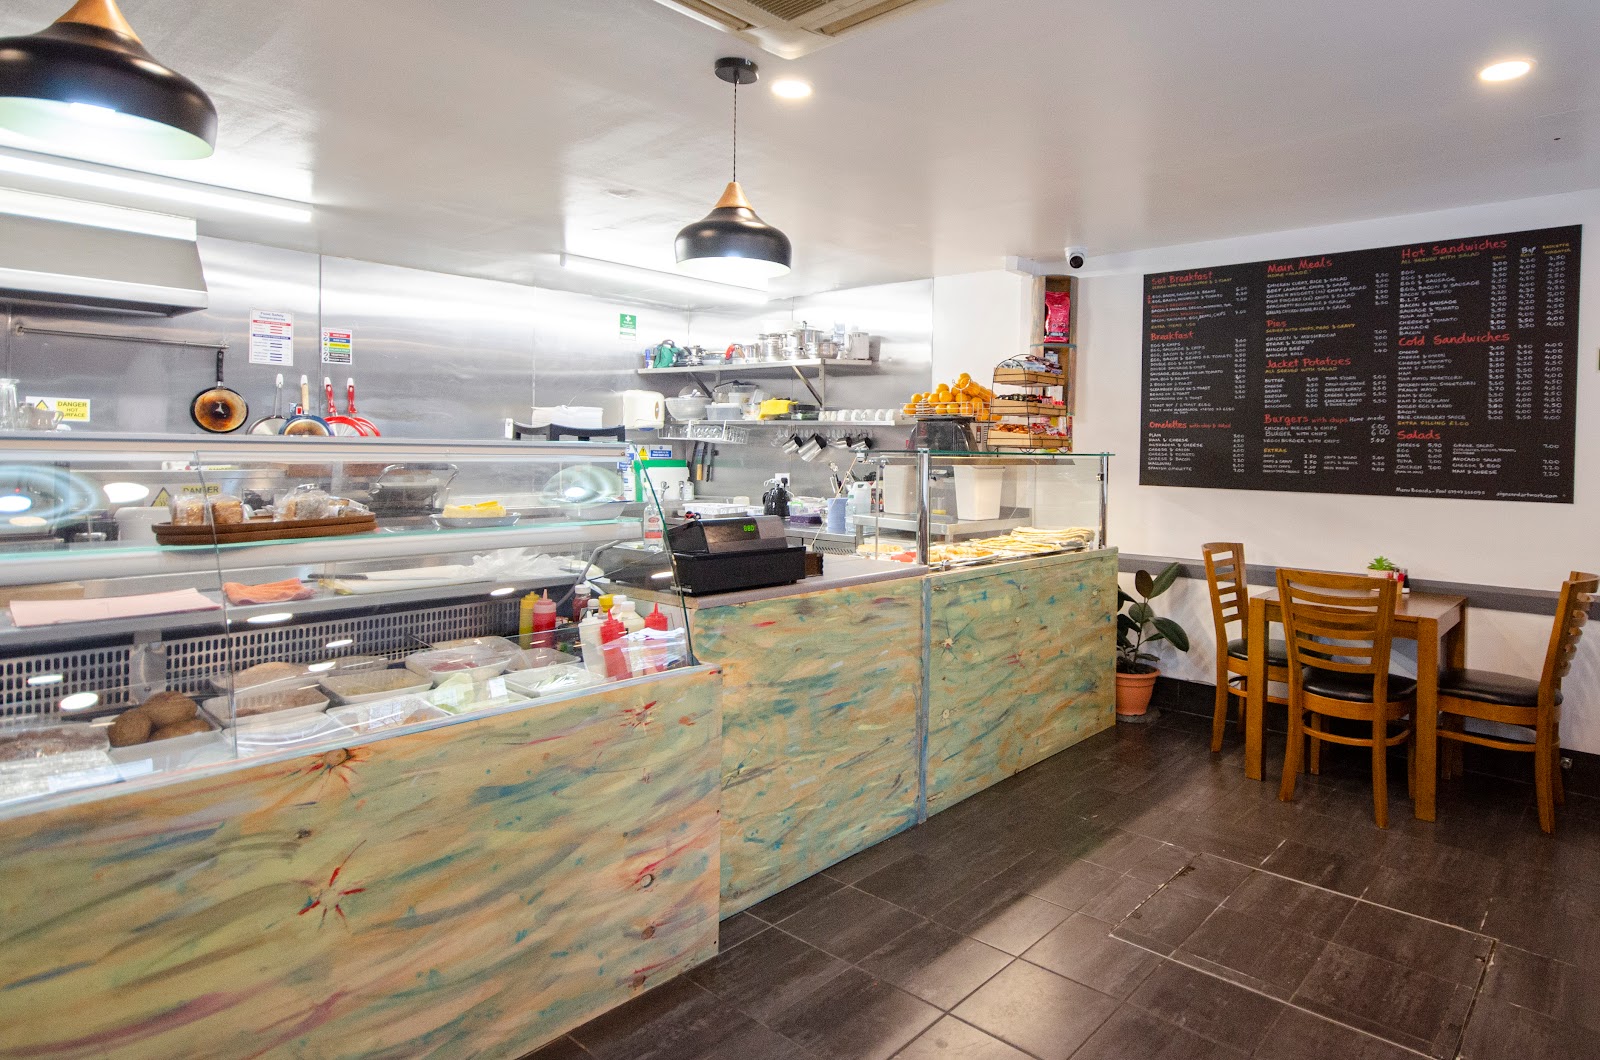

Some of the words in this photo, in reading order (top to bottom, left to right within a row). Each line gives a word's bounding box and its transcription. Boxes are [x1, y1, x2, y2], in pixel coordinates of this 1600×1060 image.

[1402, 249, 1425, 259] Hot
[1433, 239, 1507, 255] Sandwiches
[1268, 264, 1294, 273] Main
[1299, 258, 1332, 269] Meals
[1152, 277, 1166, 285] Set
[1169, 270, 1212, 283] Breakfast
[1151, 331, 1193, 340] Breakfast
[1399, 336, 1425, 346] Cold
[1434, 333, 1509, 345] Sandwiches
[1266, 359, 1299, 368] Jacket
[1303, 357, 1351, 366] Potatoes
[1149, 420, 1186, 428] Omelettes
[1264, 414, 1308, 426] Burgers
[1397, 430, 1440, 439] Salads
